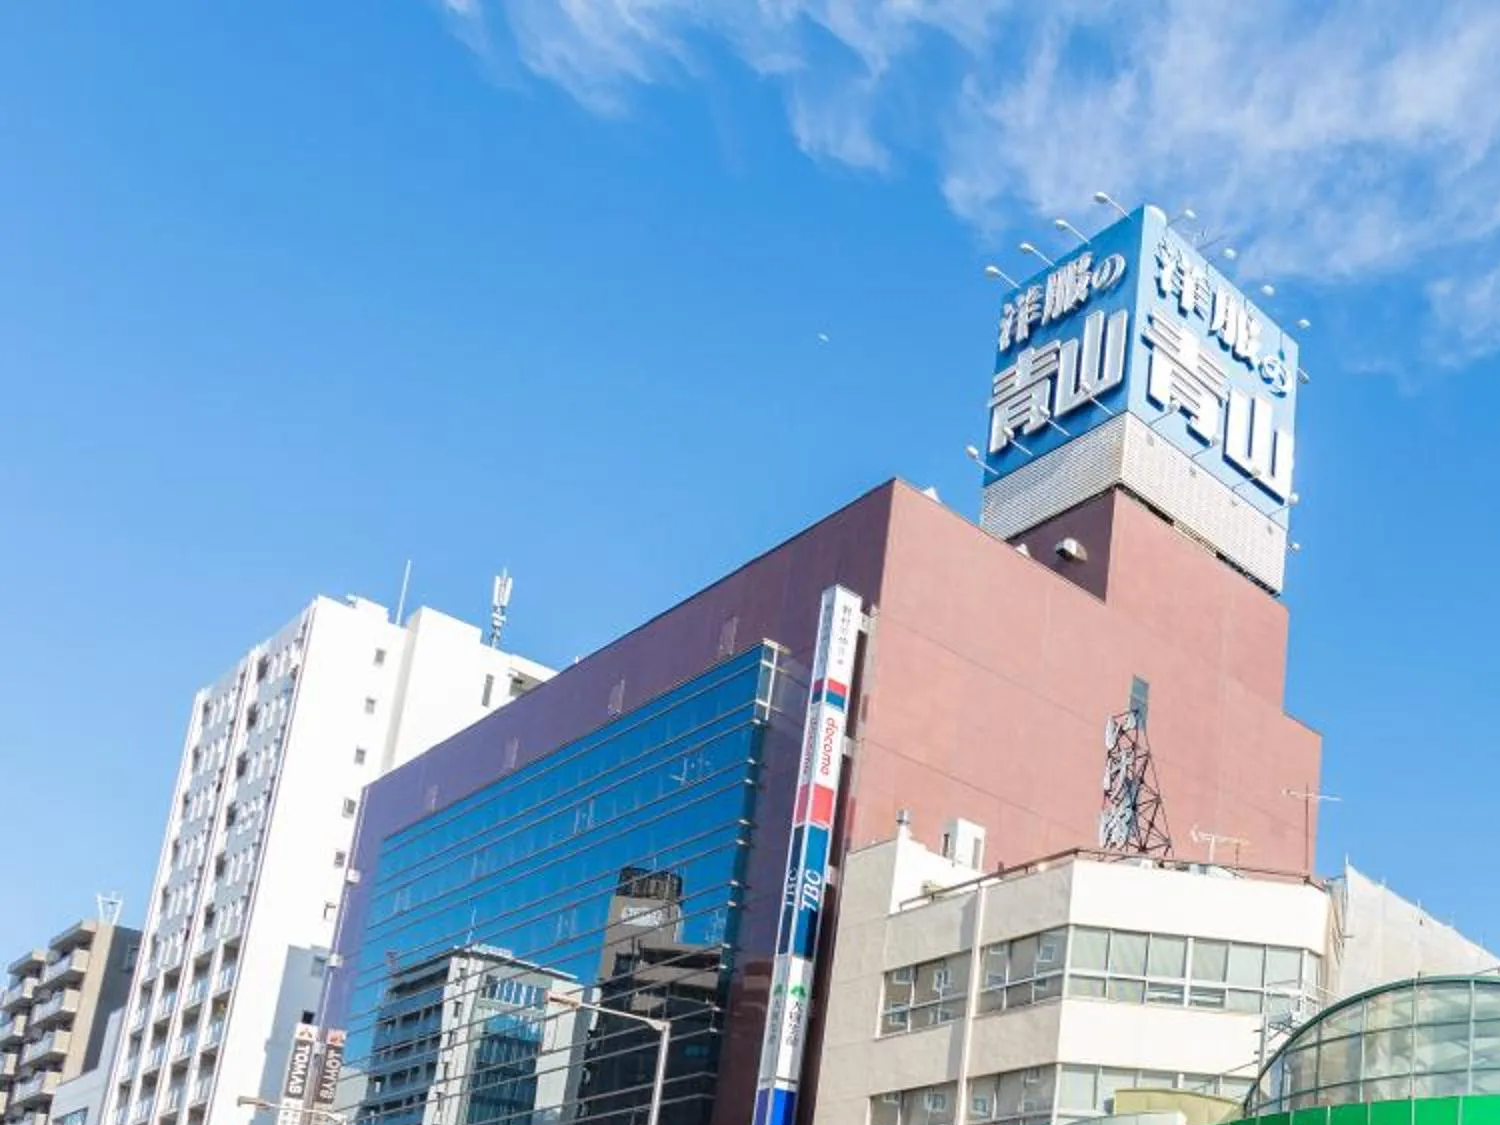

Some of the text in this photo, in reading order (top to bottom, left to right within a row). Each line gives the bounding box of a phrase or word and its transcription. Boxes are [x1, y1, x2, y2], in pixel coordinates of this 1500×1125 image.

[999, 250, 1127, 351] 洋服の
[1152, 235, 1293, 397] 洋服の
[990, 310, 1128, 453] 青山
[1142, 308, 1287, 505] 青山
[818, 716, 838, 777] docomo
[801, 868, 823, 912] TBC
[288, 1045, 310, 1094] TOMAS
